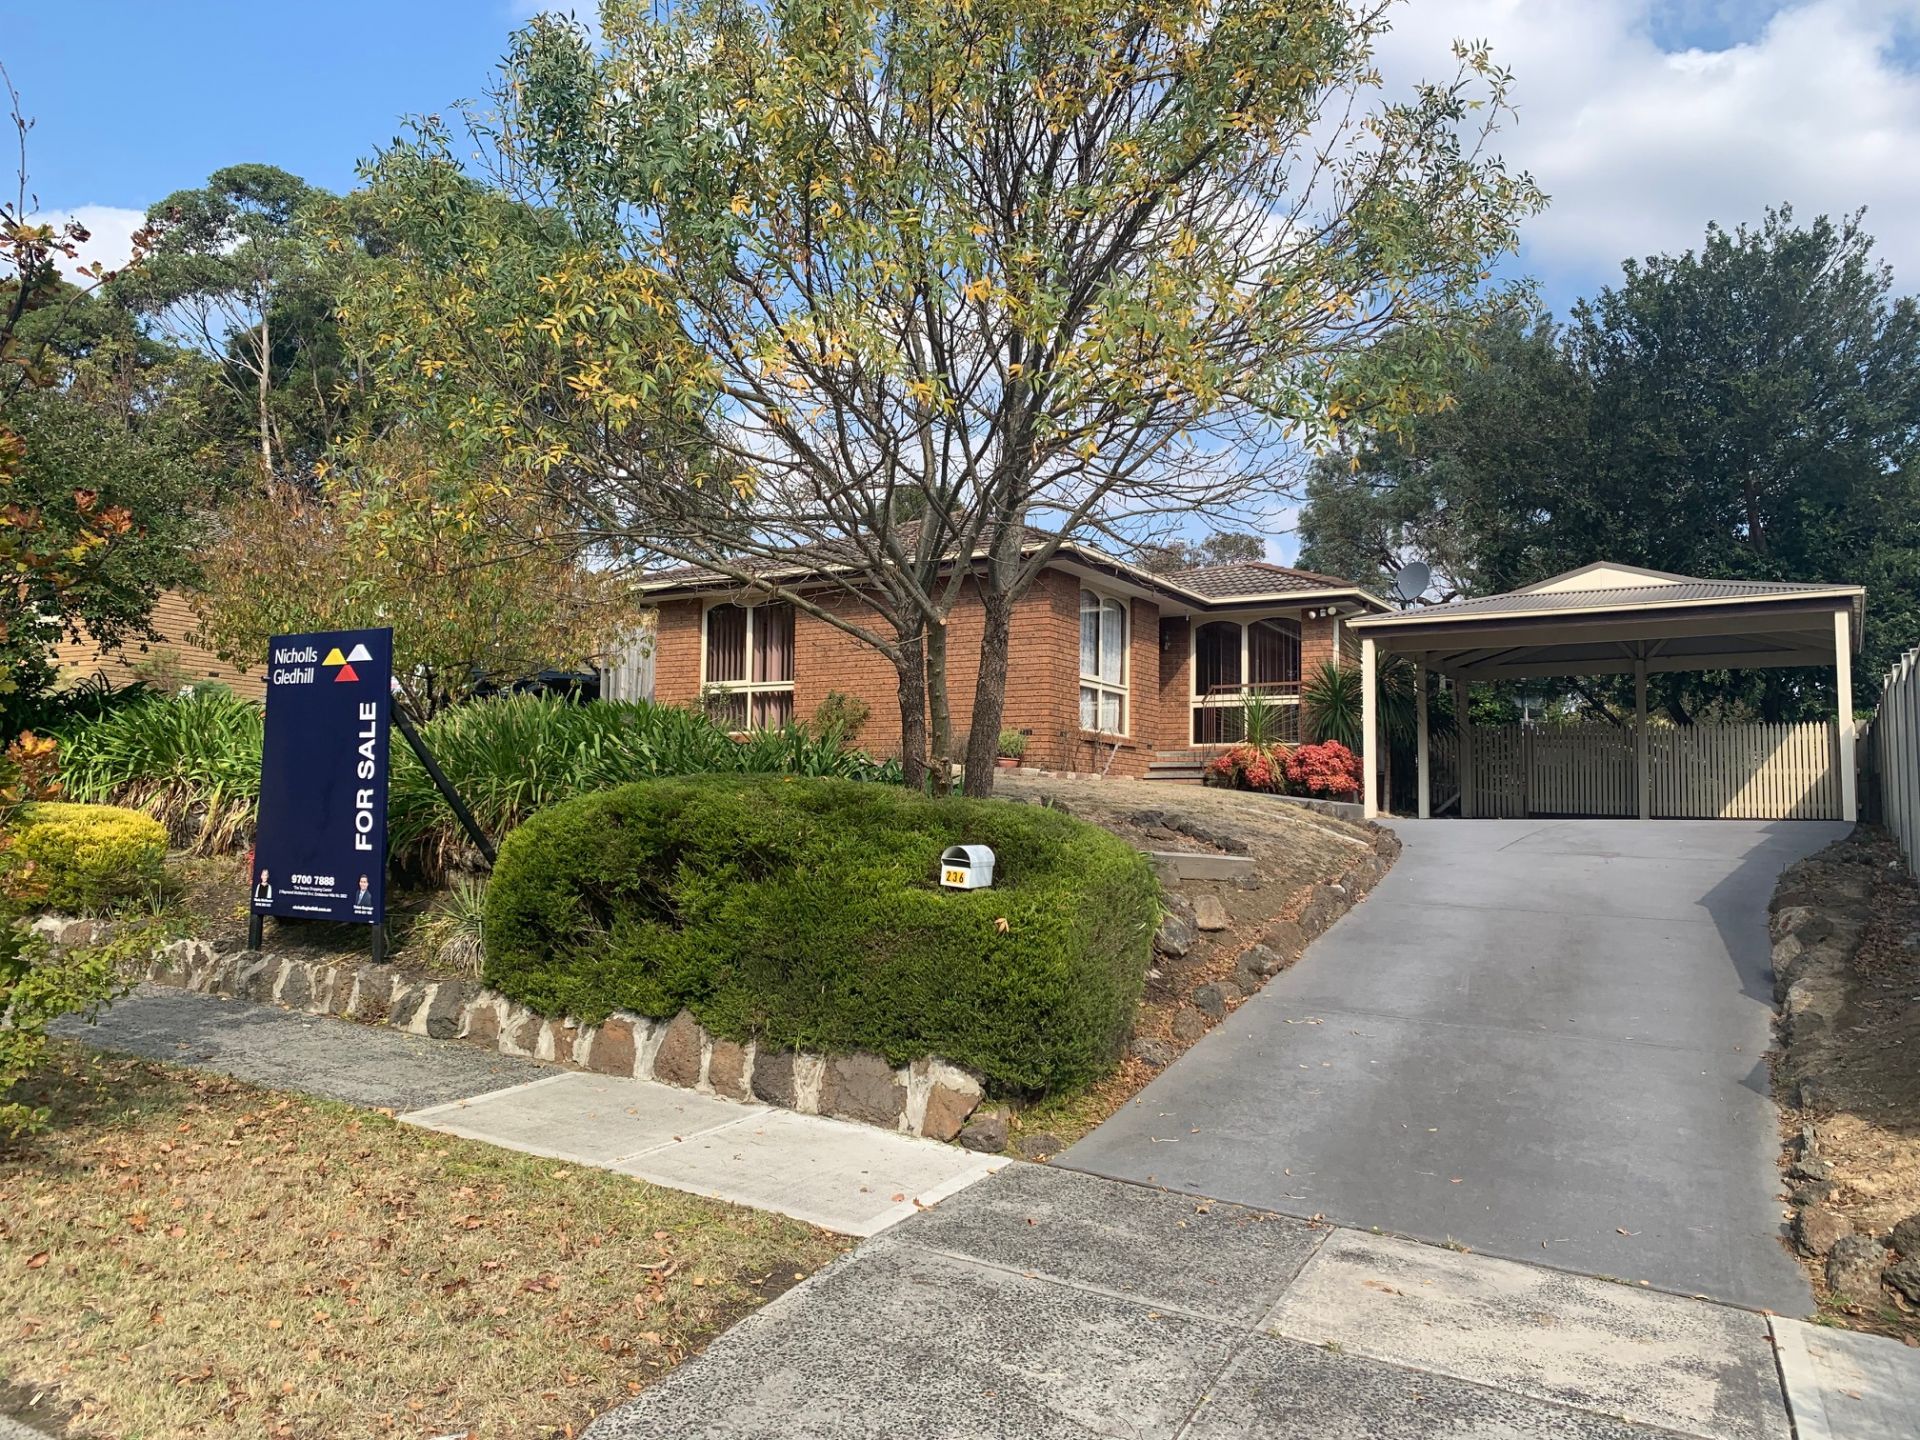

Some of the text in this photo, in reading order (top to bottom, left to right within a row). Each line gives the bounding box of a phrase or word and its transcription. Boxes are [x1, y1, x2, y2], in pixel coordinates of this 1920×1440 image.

[274, 646, 318, 664] Nicholls
[273, 667, 314, 685] Gledhill
[355, 702, 376, 850] FOR SALE
[291, 874, 335, 886] 9700 7888
[946, 871, 964, 883] 236
